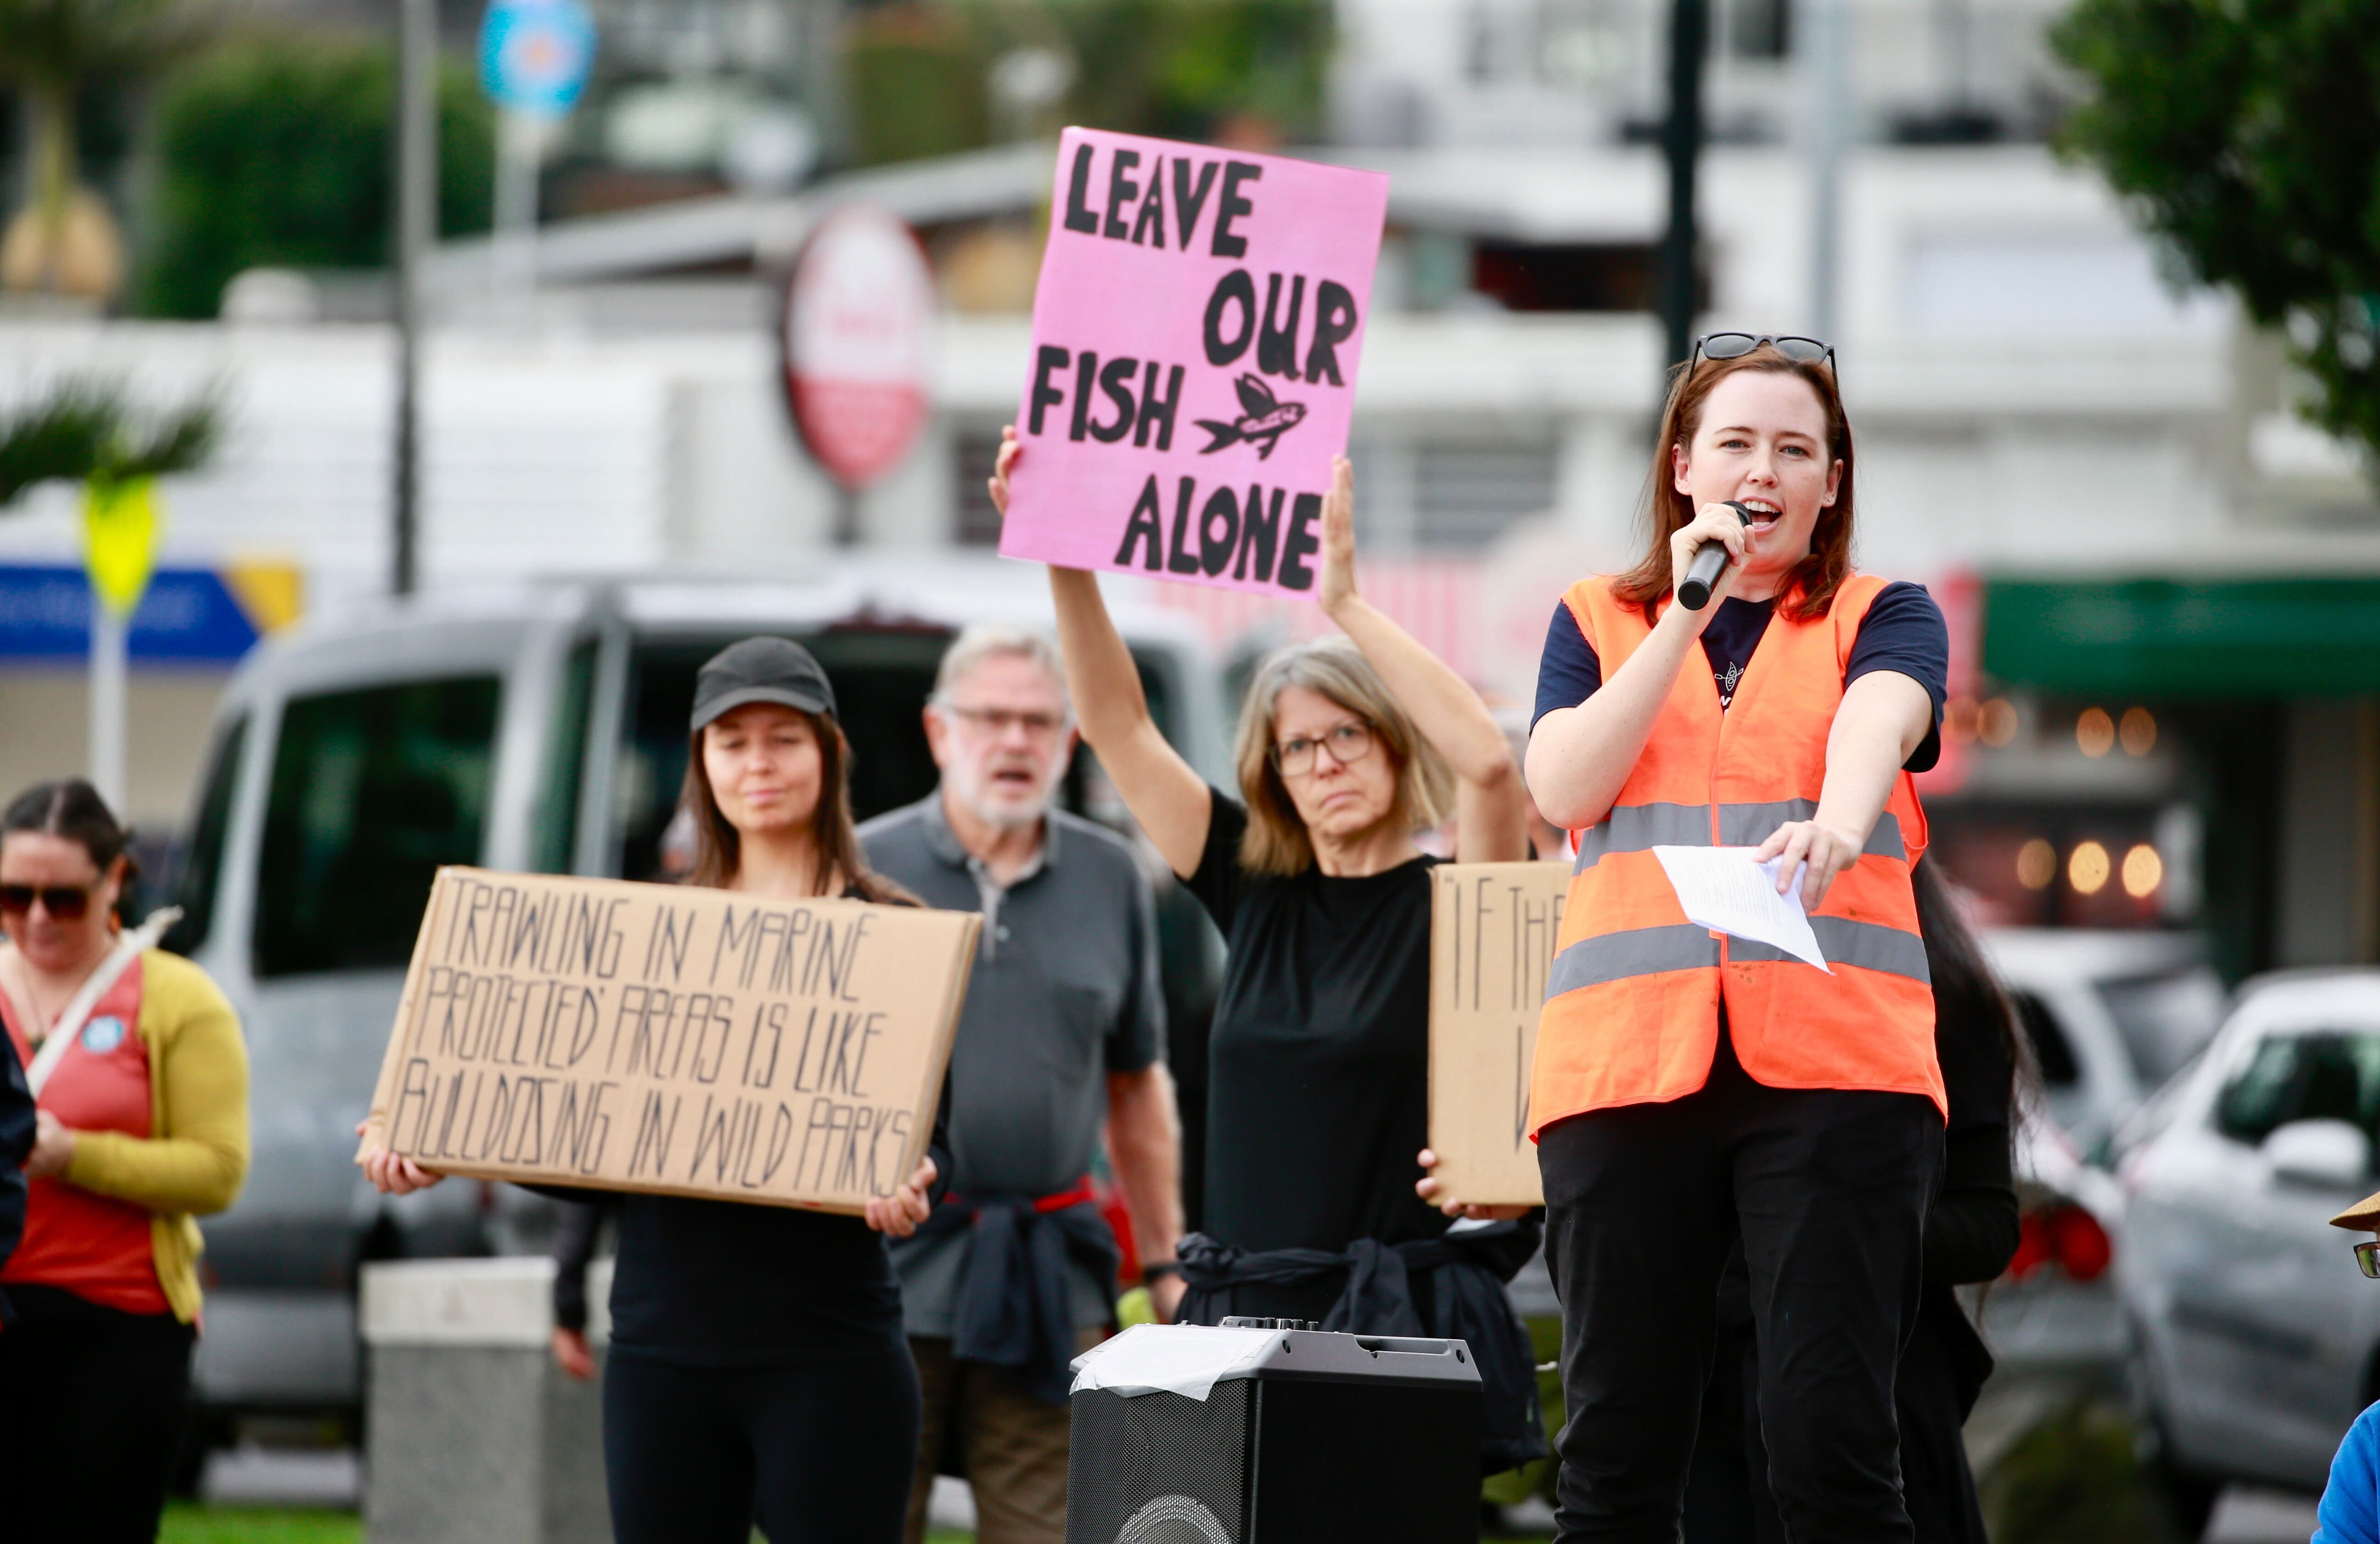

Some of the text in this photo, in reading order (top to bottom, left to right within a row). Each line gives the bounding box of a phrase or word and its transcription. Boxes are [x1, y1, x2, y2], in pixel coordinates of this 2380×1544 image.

[1064, 143, 1263, 259] LEAVE
[1203, 269, 1358, 387] OUR
[1028, 345, 1185, 451] FISH
[1114, 473, 1323, 590] ALONE
[444, 877, 877, 1002] TRAWLING IN MARINE
[605, 985, 734, 1084] AREAS
[741, 1002, 789, 1089] IS
[795, 1005, 888, 1098] LIKE
[389, 1057, 913, 1199] BULLDOSING IN WILD PARKS
